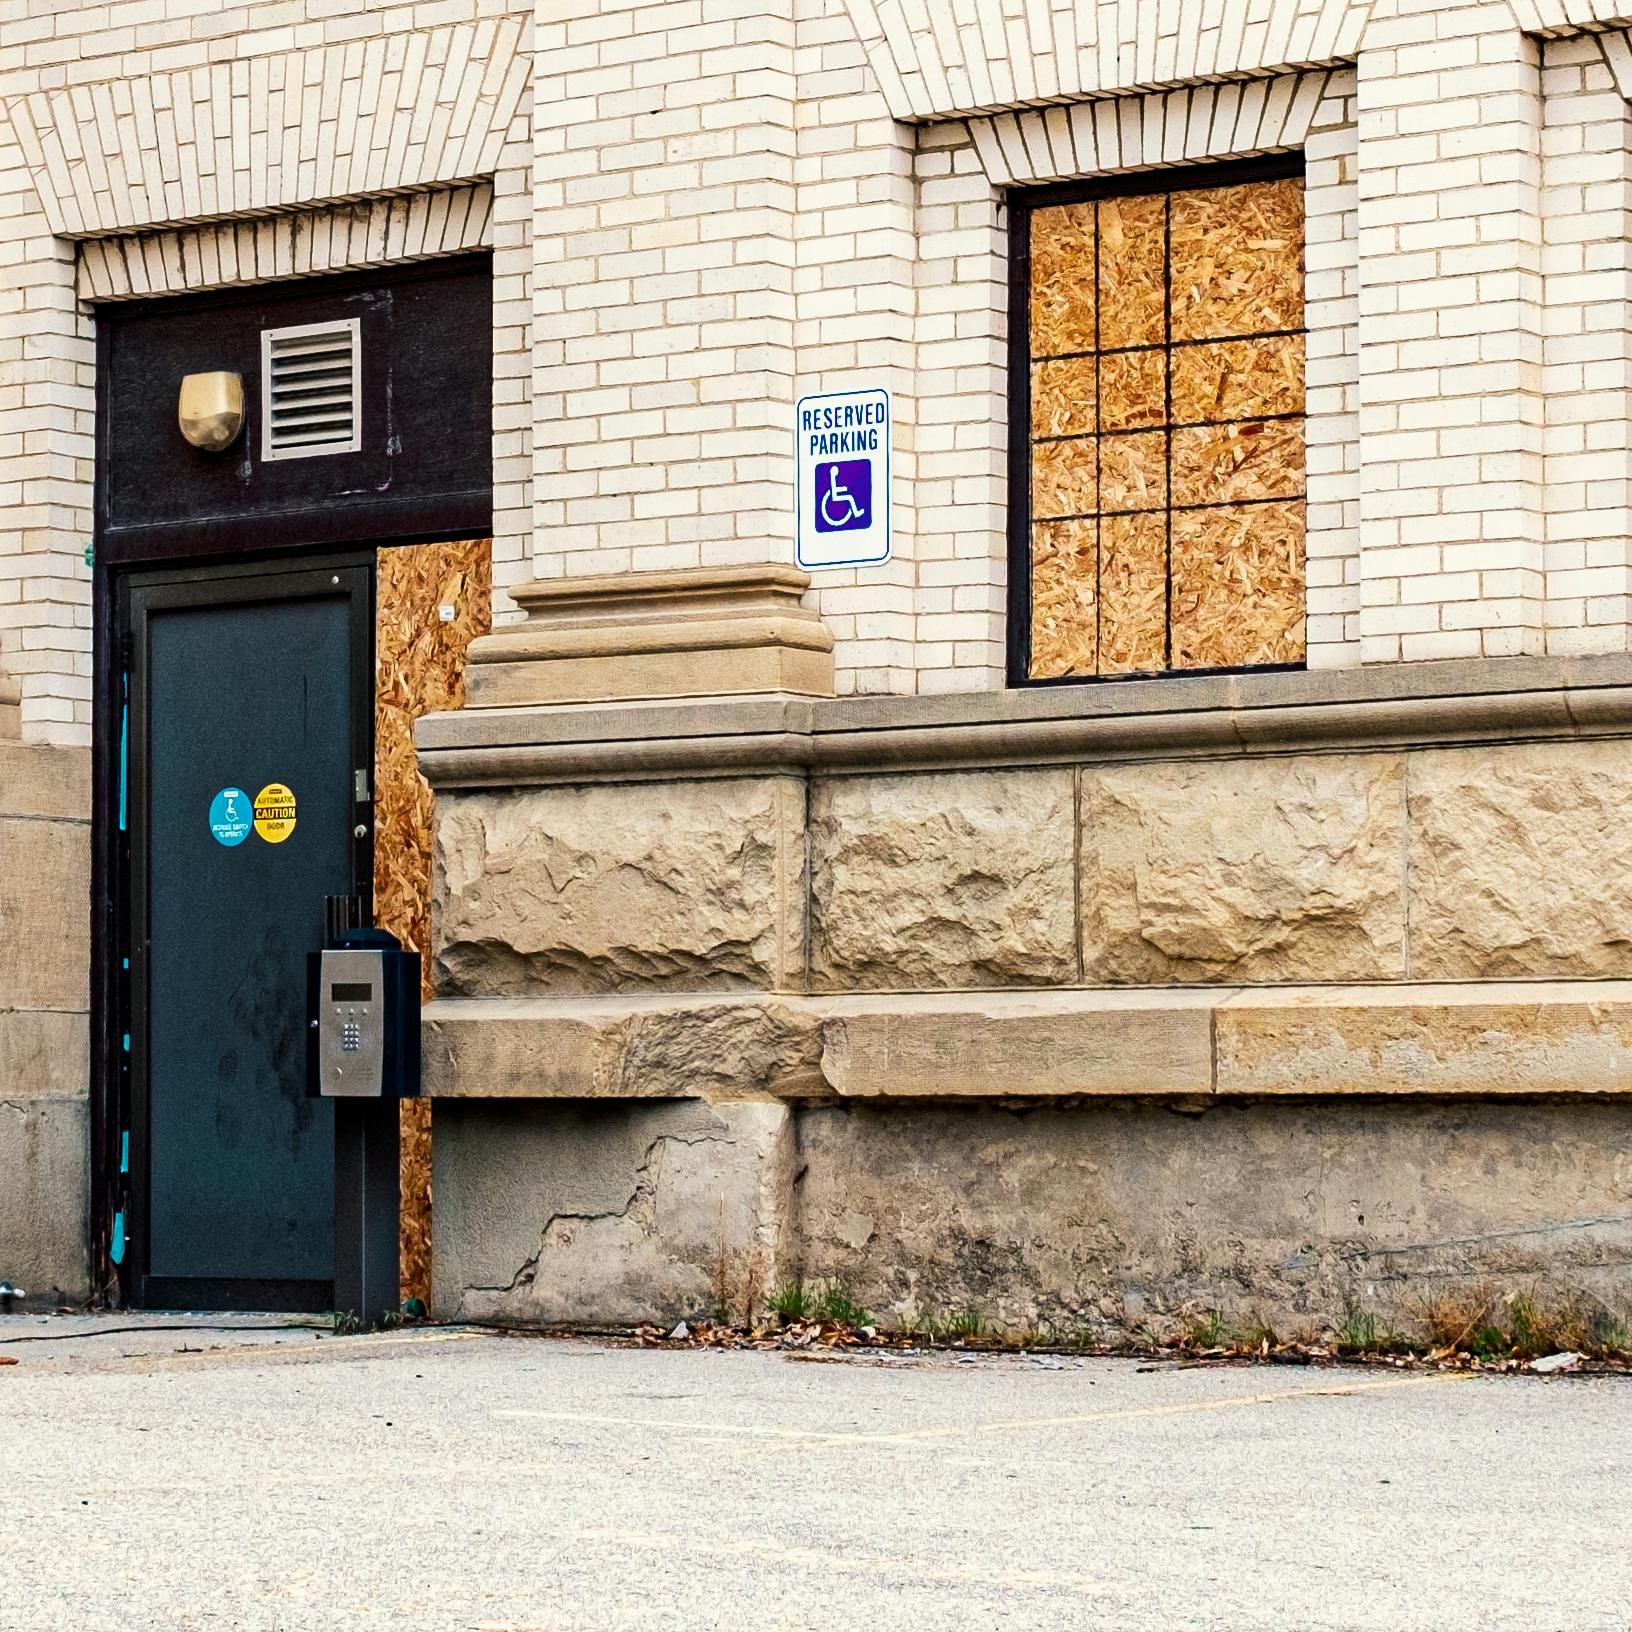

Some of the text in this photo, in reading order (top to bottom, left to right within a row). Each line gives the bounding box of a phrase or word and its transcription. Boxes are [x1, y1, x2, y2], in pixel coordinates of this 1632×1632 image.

[802, 402, 885, 432] RESERVED
[809, 429, 878, 456] PARKING
[257, 795, 294, 805] AUTOMATIC
[255, 807, 296, 819] CAUTION
